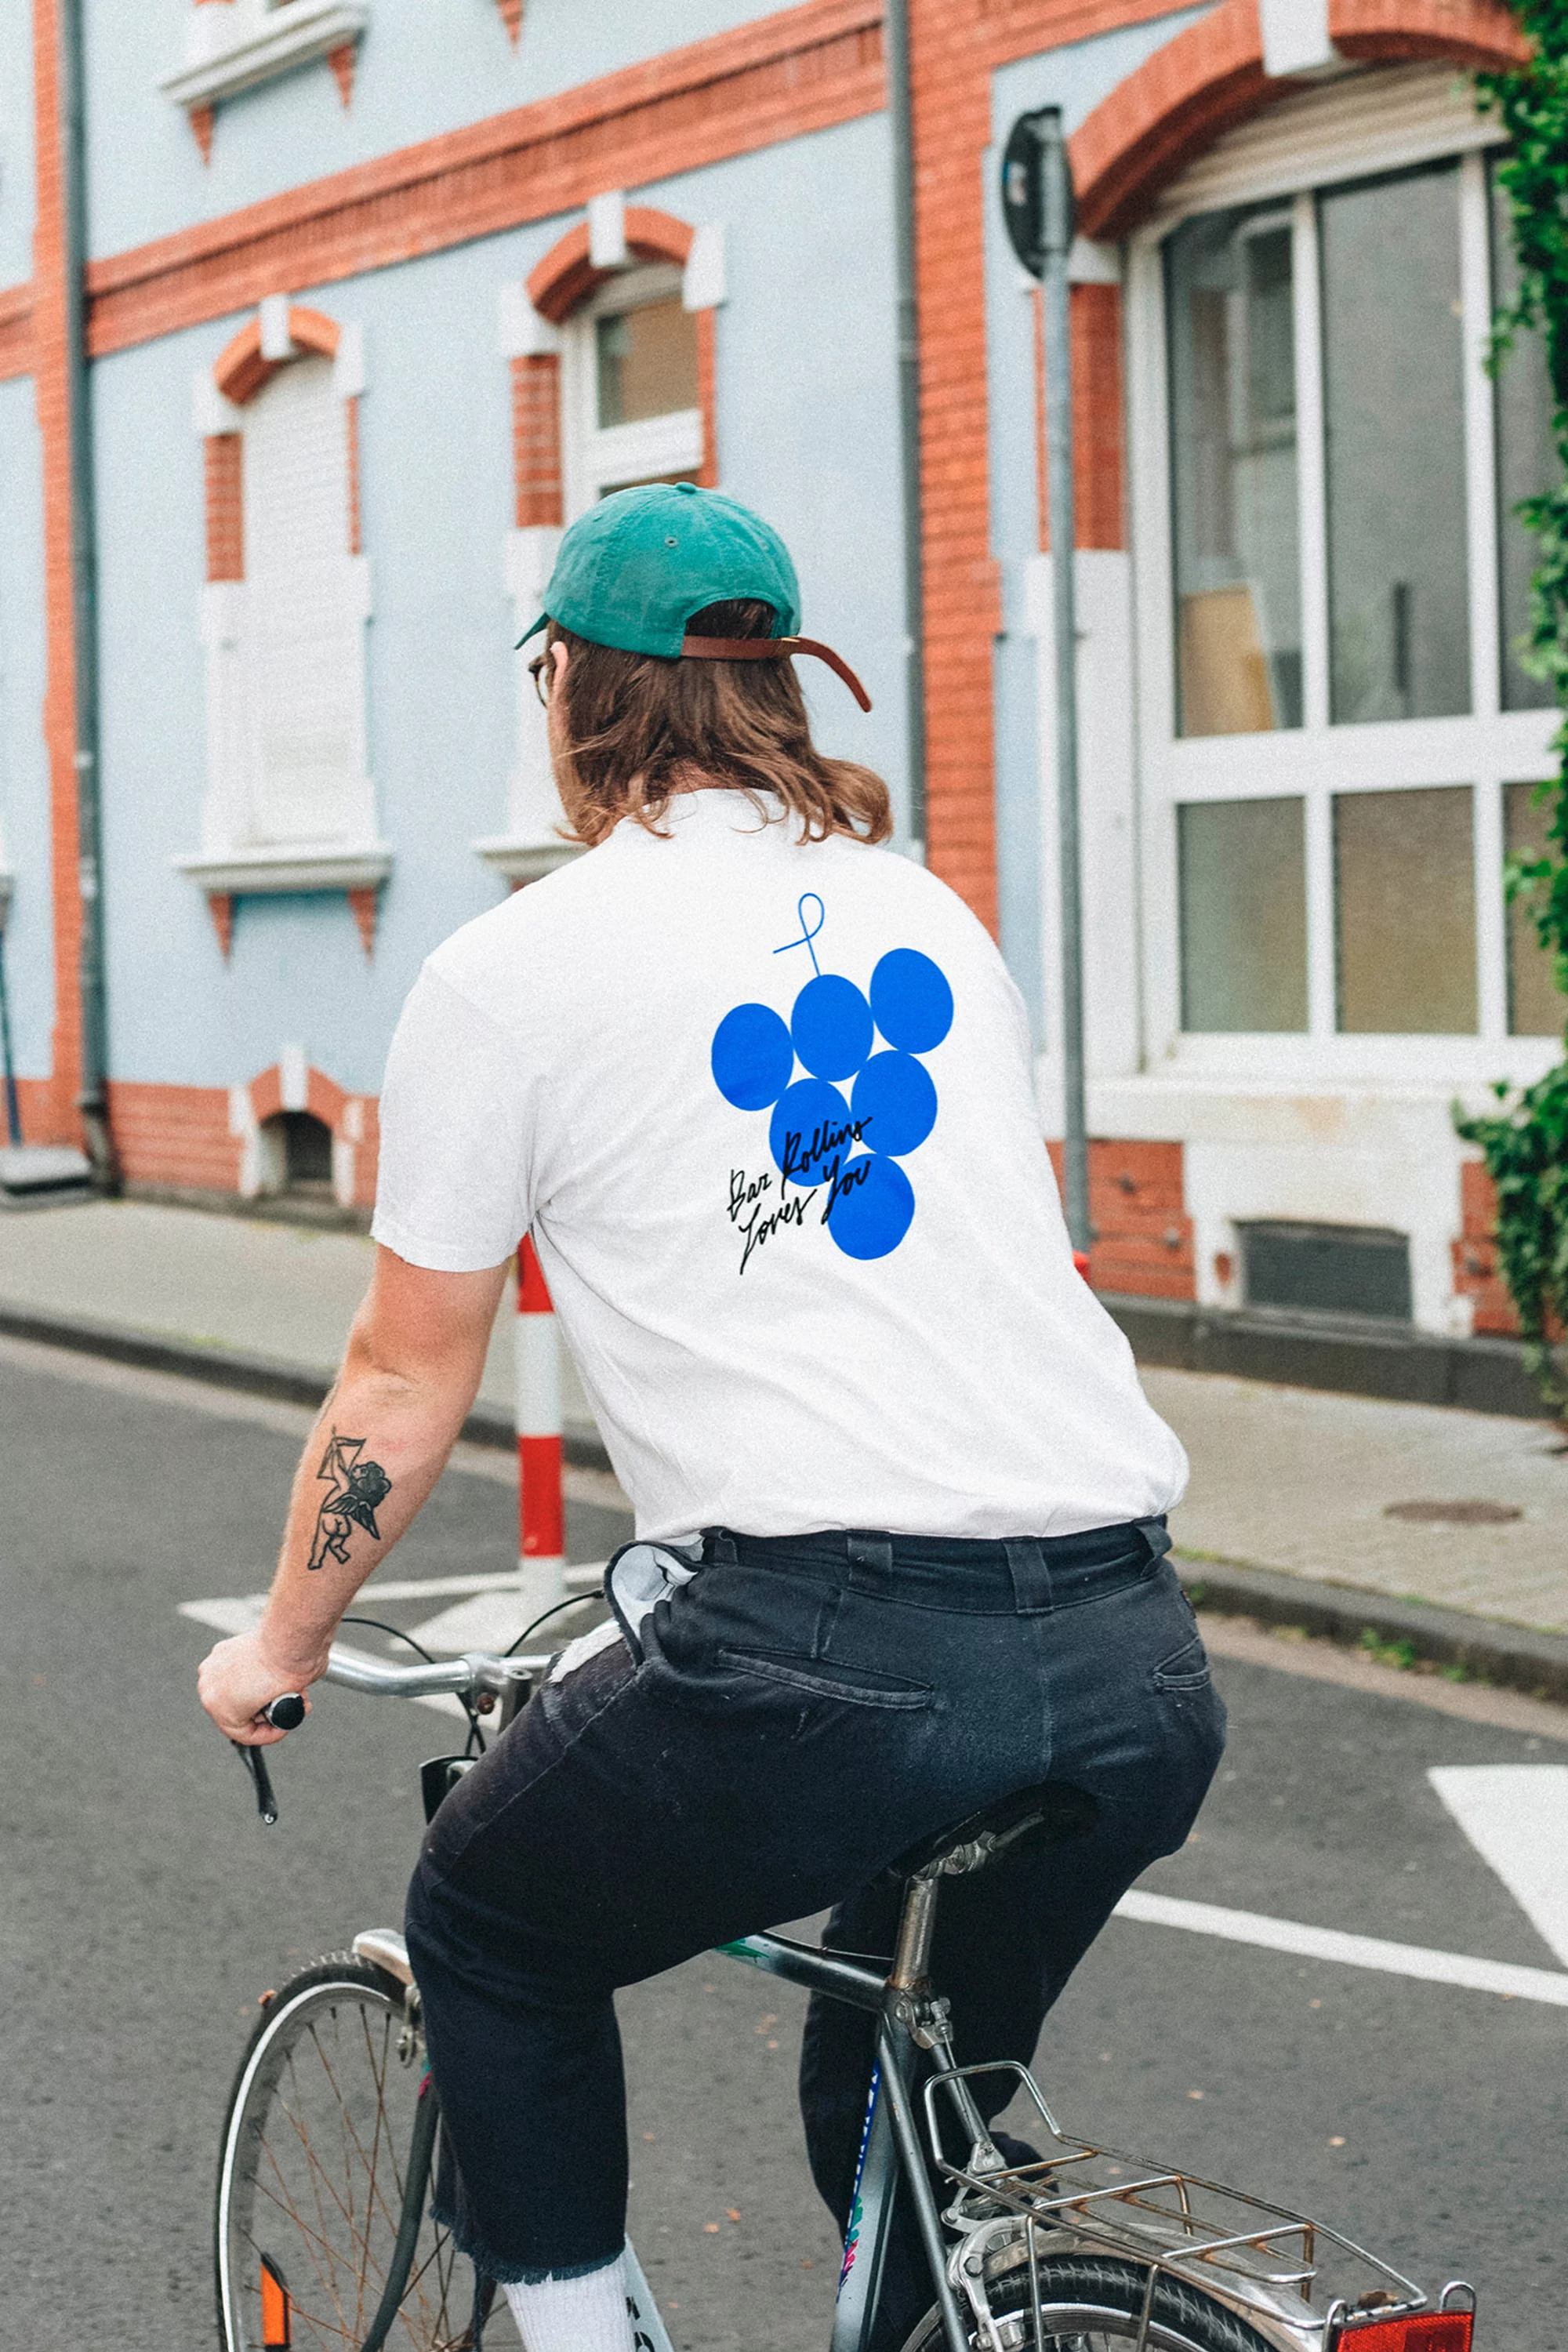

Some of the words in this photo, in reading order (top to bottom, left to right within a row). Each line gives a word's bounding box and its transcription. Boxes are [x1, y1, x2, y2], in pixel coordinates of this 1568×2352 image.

[727, 1169, 773, 1222] Bar
[782, 1116, 873, 1200] Rollins
[739, 1189, 818, 1276] Loves
[821, 1155, 871, 1225] You
